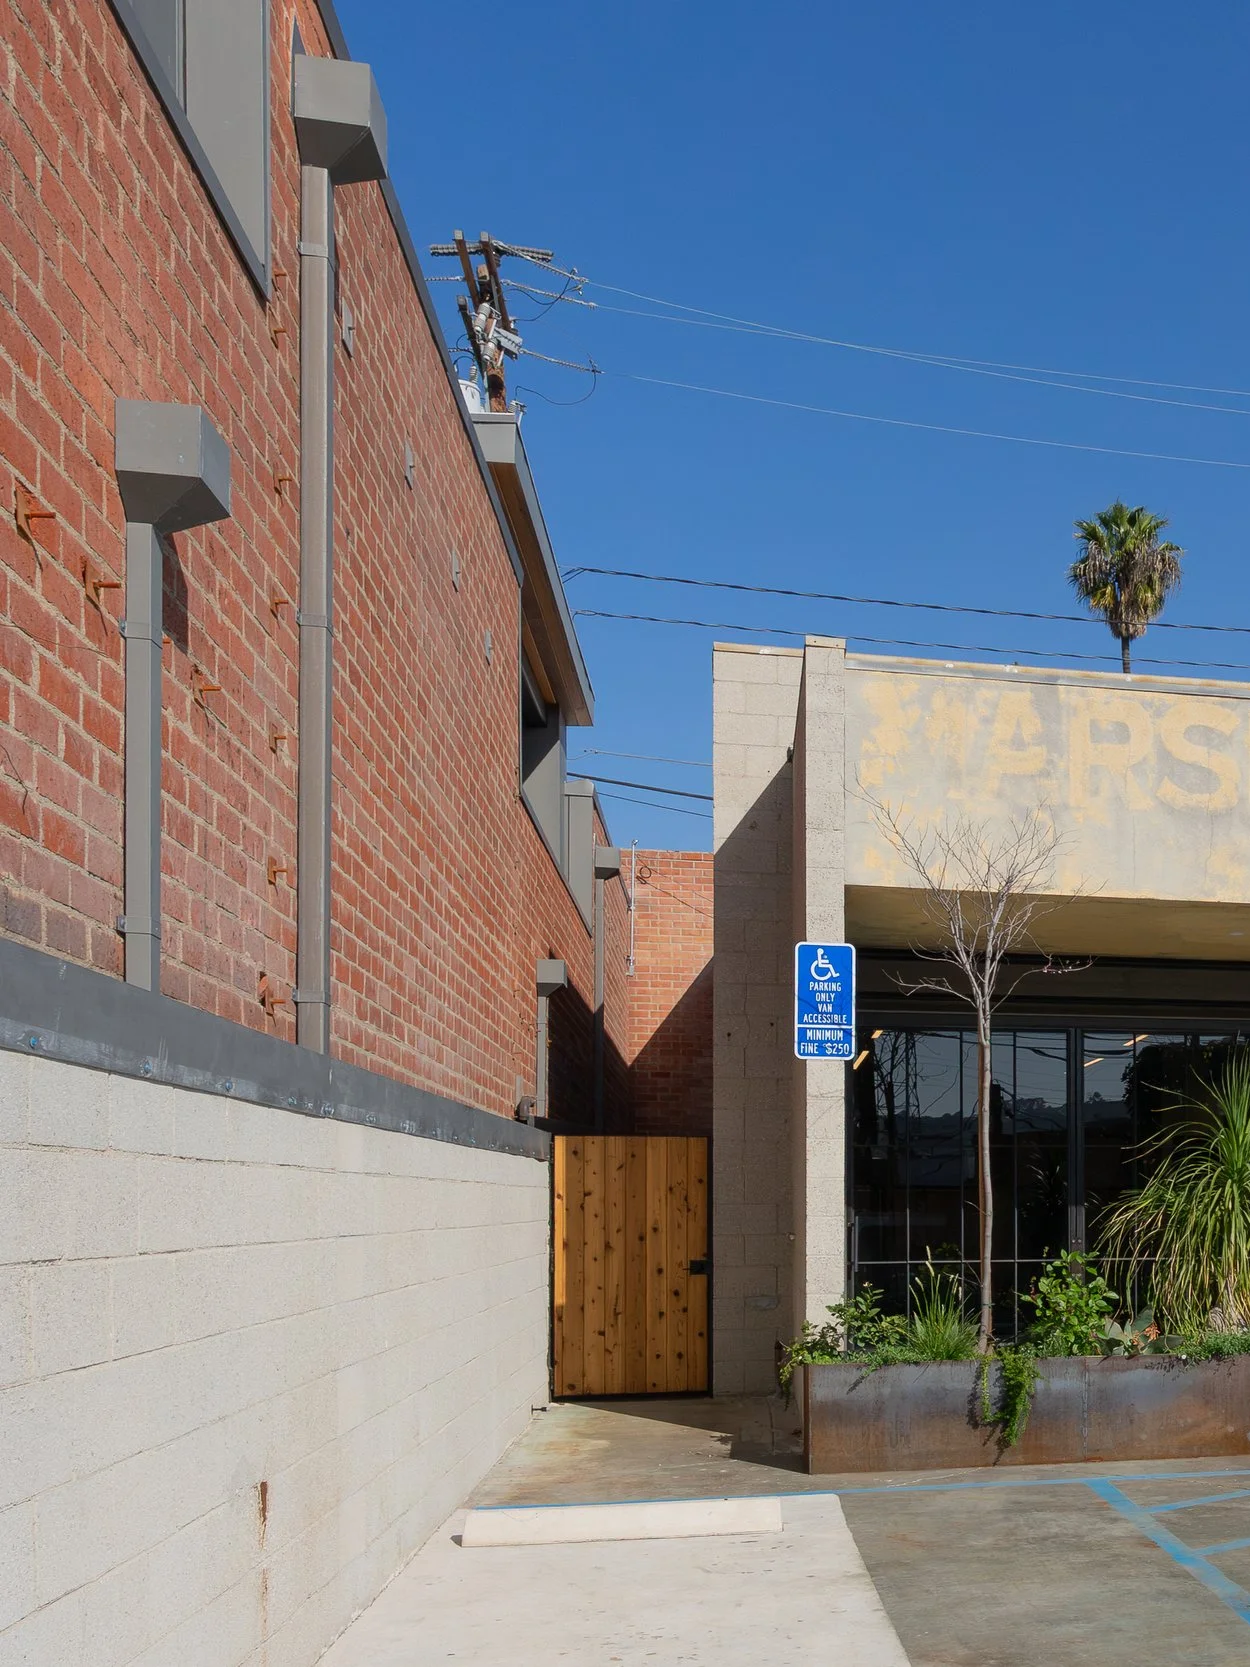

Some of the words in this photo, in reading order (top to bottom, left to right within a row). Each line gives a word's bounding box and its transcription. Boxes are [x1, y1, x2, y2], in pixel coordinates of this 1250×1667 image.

[809, 981, 842, 992] PARKING
[815, 992, 835, 1002] ONLY
[817, 1003, 833, 1013] VAN
[803, 1013, 847, 1024] ACCESSIBLE
[806, 1029, 843, 1041] MINIMUM
[800, 1042, 818, 1054] FINE
[825, 1042, 850, 1055] $250
